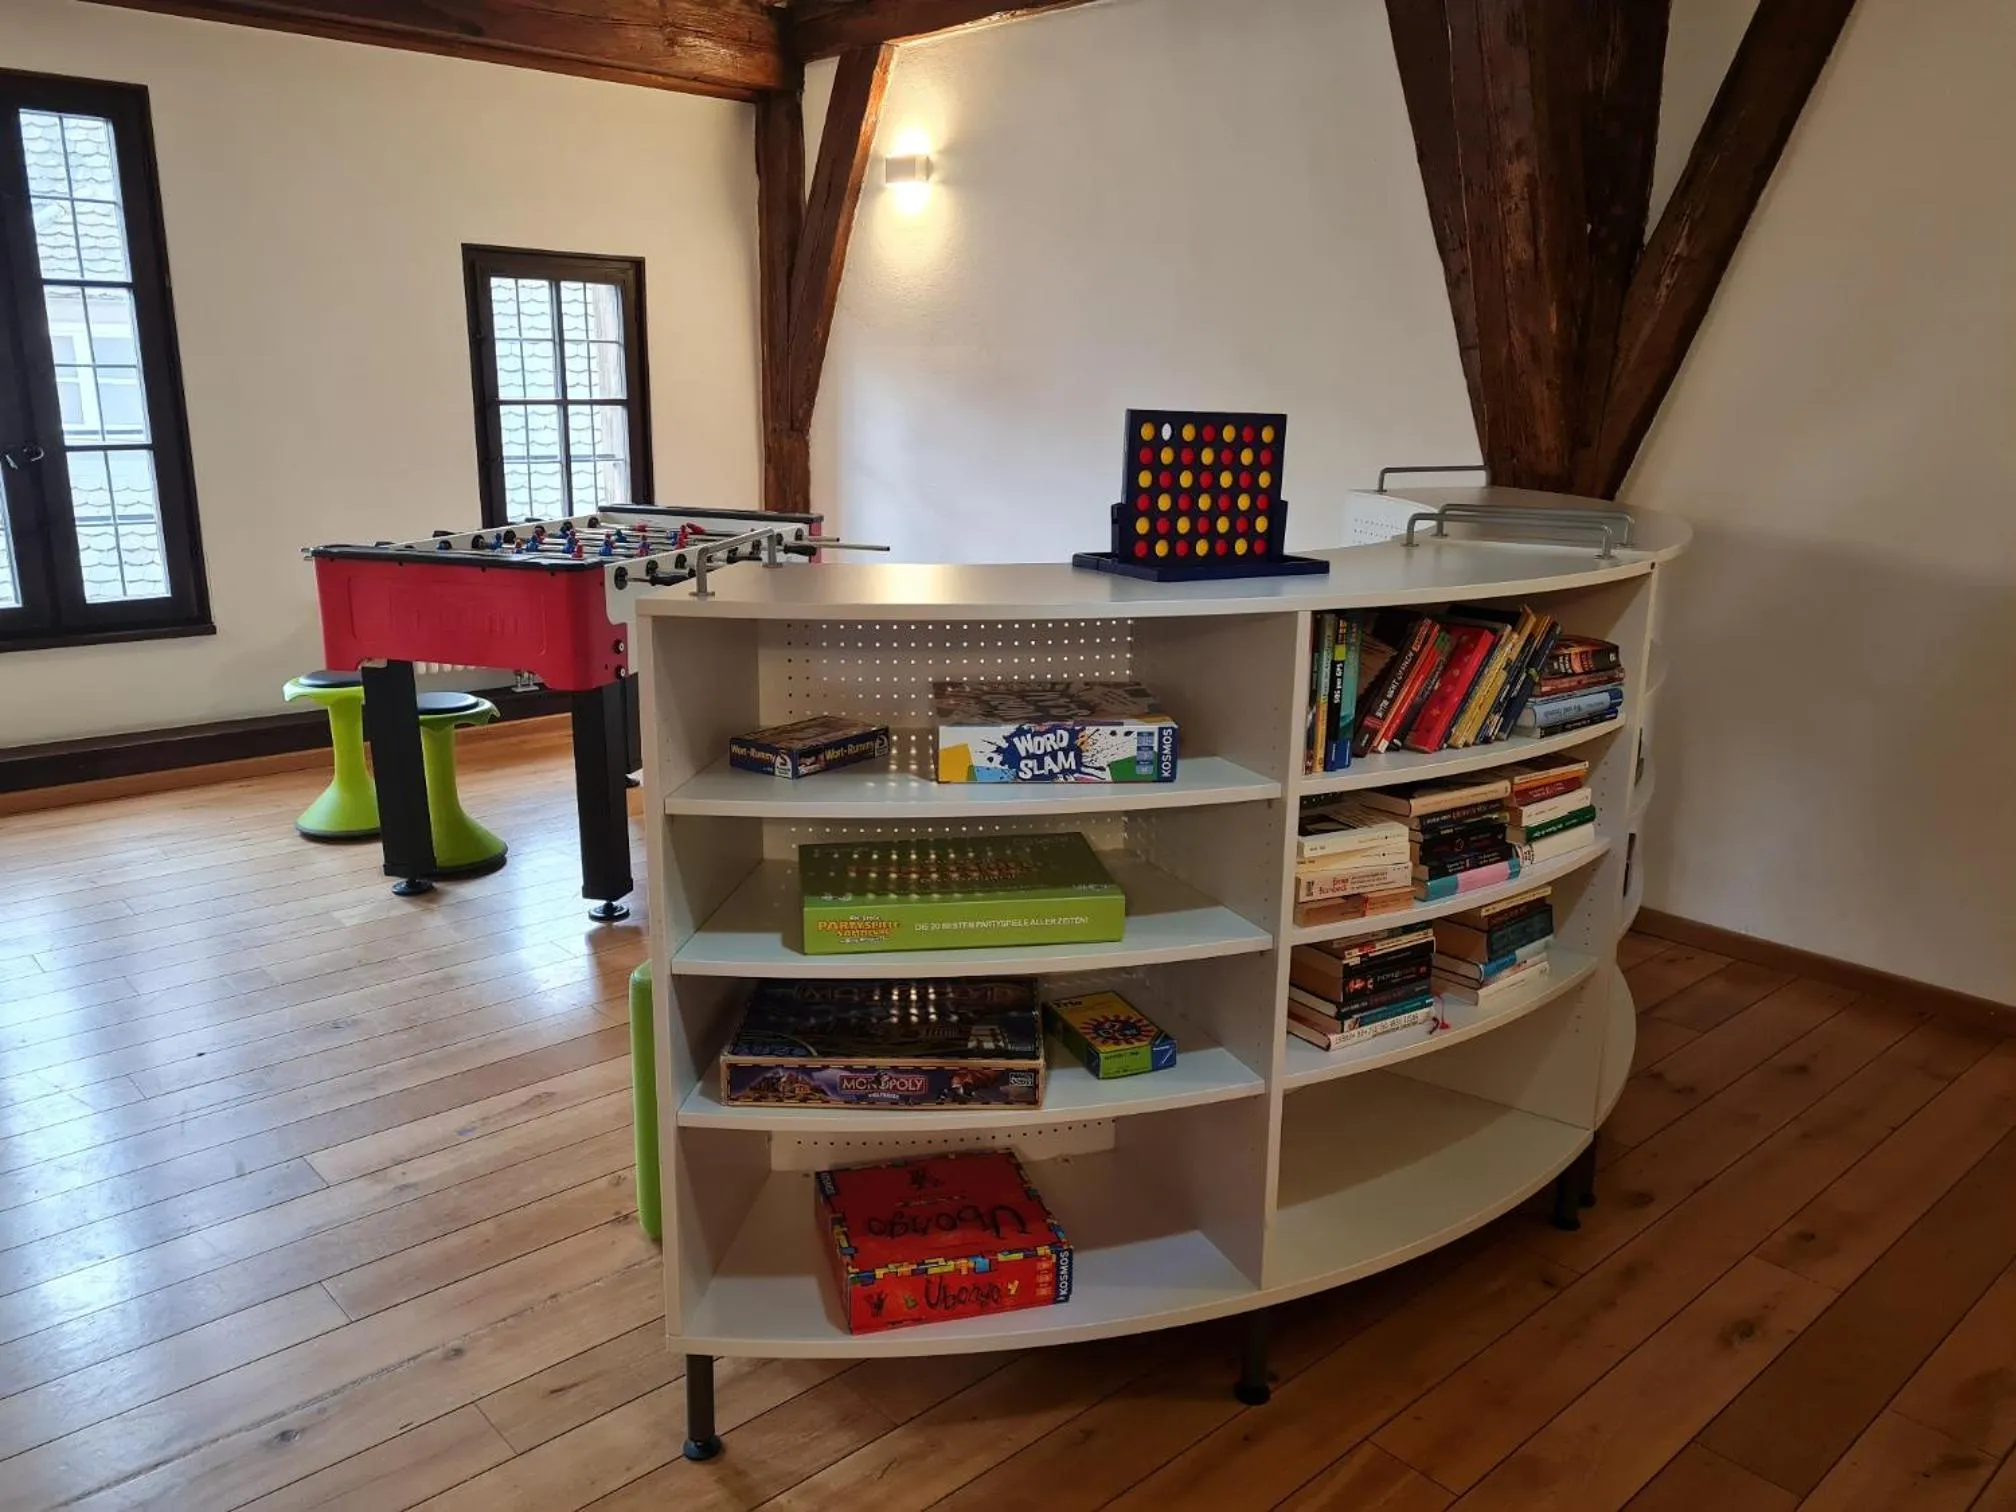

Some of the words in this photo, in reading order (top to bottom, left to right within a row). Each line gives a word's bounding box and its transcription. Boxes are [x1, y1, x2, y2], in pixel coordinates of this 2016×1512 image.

[824, 740, 874, 762] Wort-Rummy
[1013, 729, 1069, 758] WORD
[1161, 728, 1173, 778] KOSMOS
[1018, 751, 1076, 780] SLAM
[842, 1076, 924, 1091] MONOPOLY
[867, 1205, 1032, 1240] Ubongo
[1058, 1250, 1070, 1297] KOSMOS
